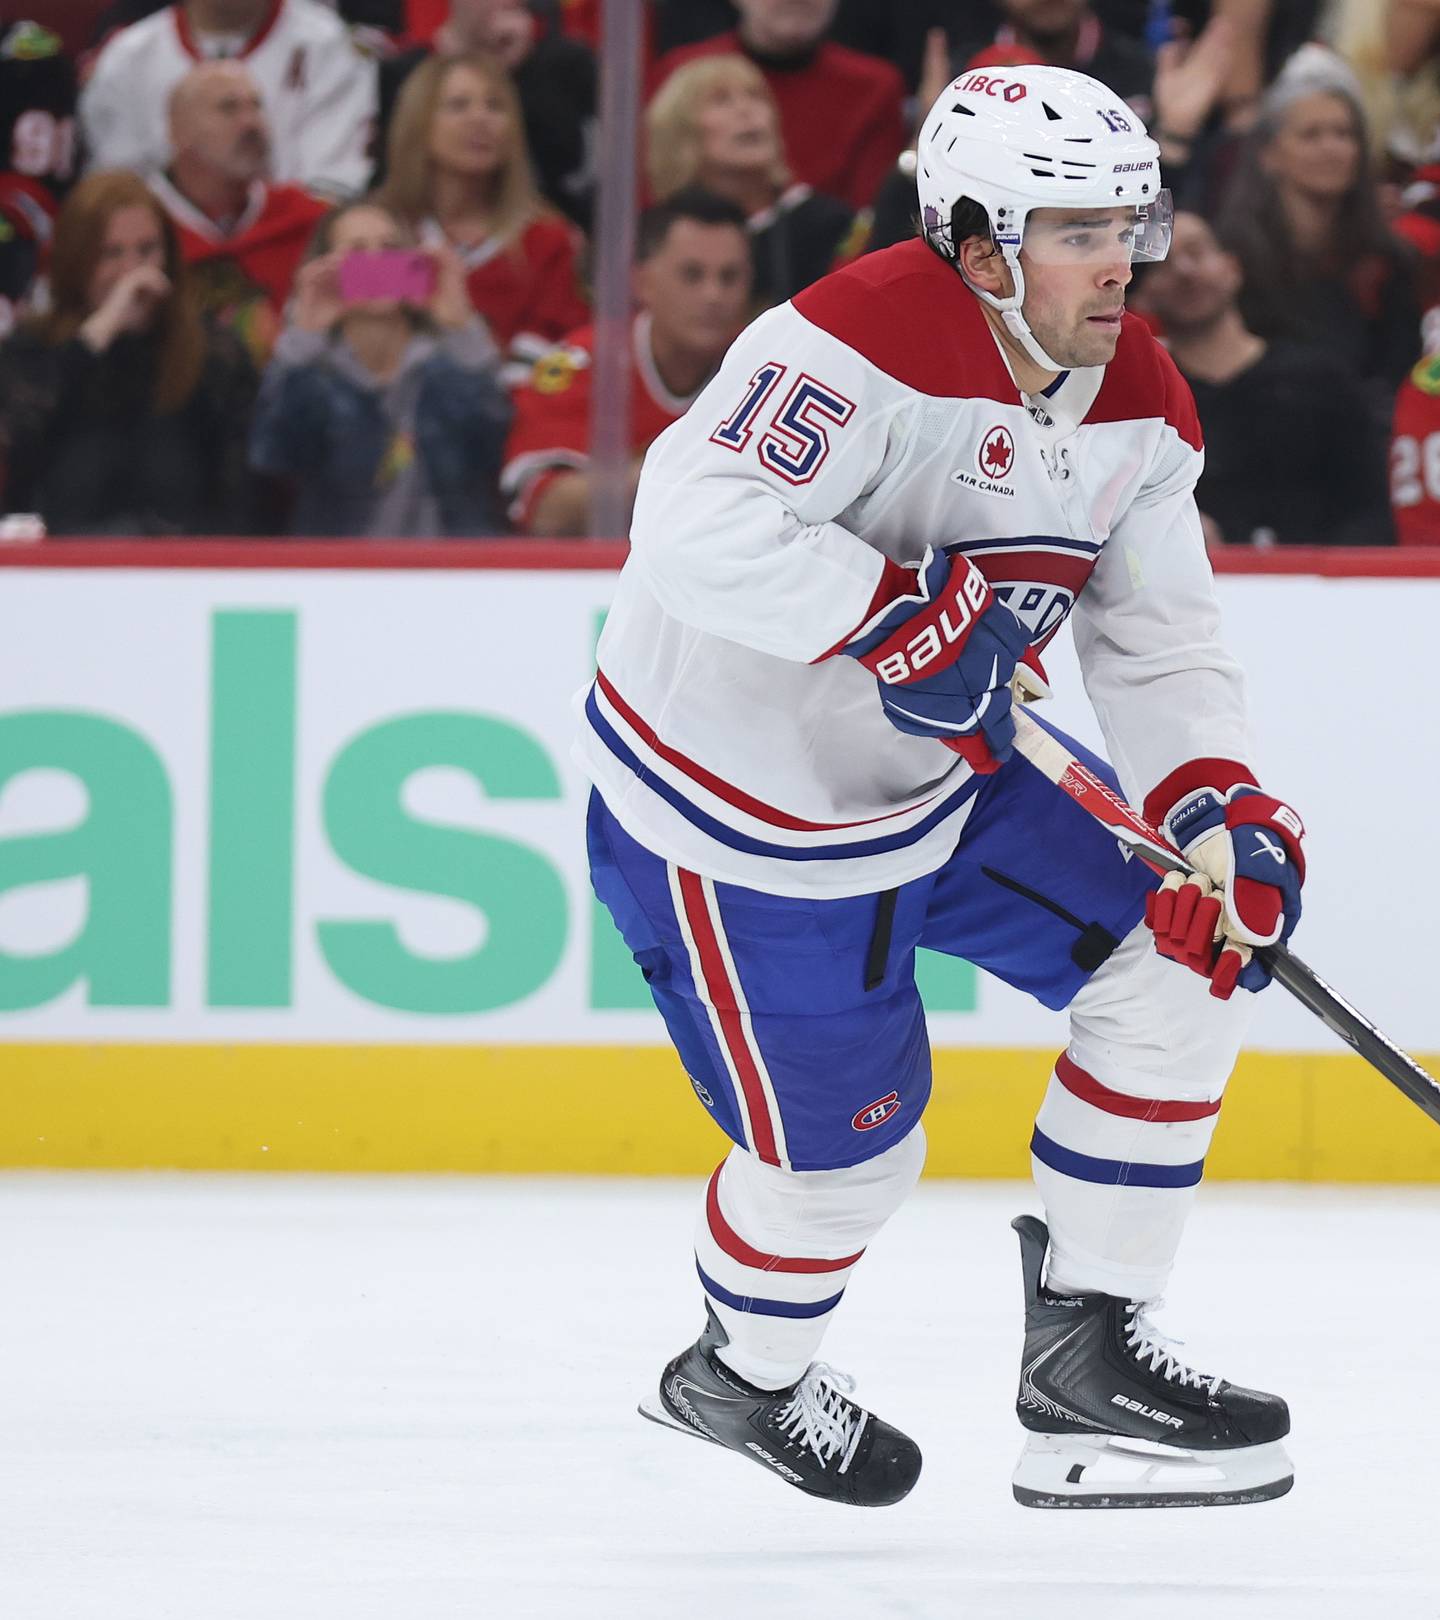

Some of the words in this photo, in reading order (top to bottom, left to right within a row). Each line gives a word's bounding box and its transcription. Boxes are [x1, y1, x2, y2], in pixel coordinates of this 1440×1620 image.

[953, 74, 1005, 97] CIBC
[1096, 109, 1131, 132] 15
[708, 361, 857, 486] 15
[956, 473, 977, 486] AIR
[978, 481, 1015, 497] CANADA
[876, 563, 988, 685] BAUE
[0, 608, 978, 1017] als
